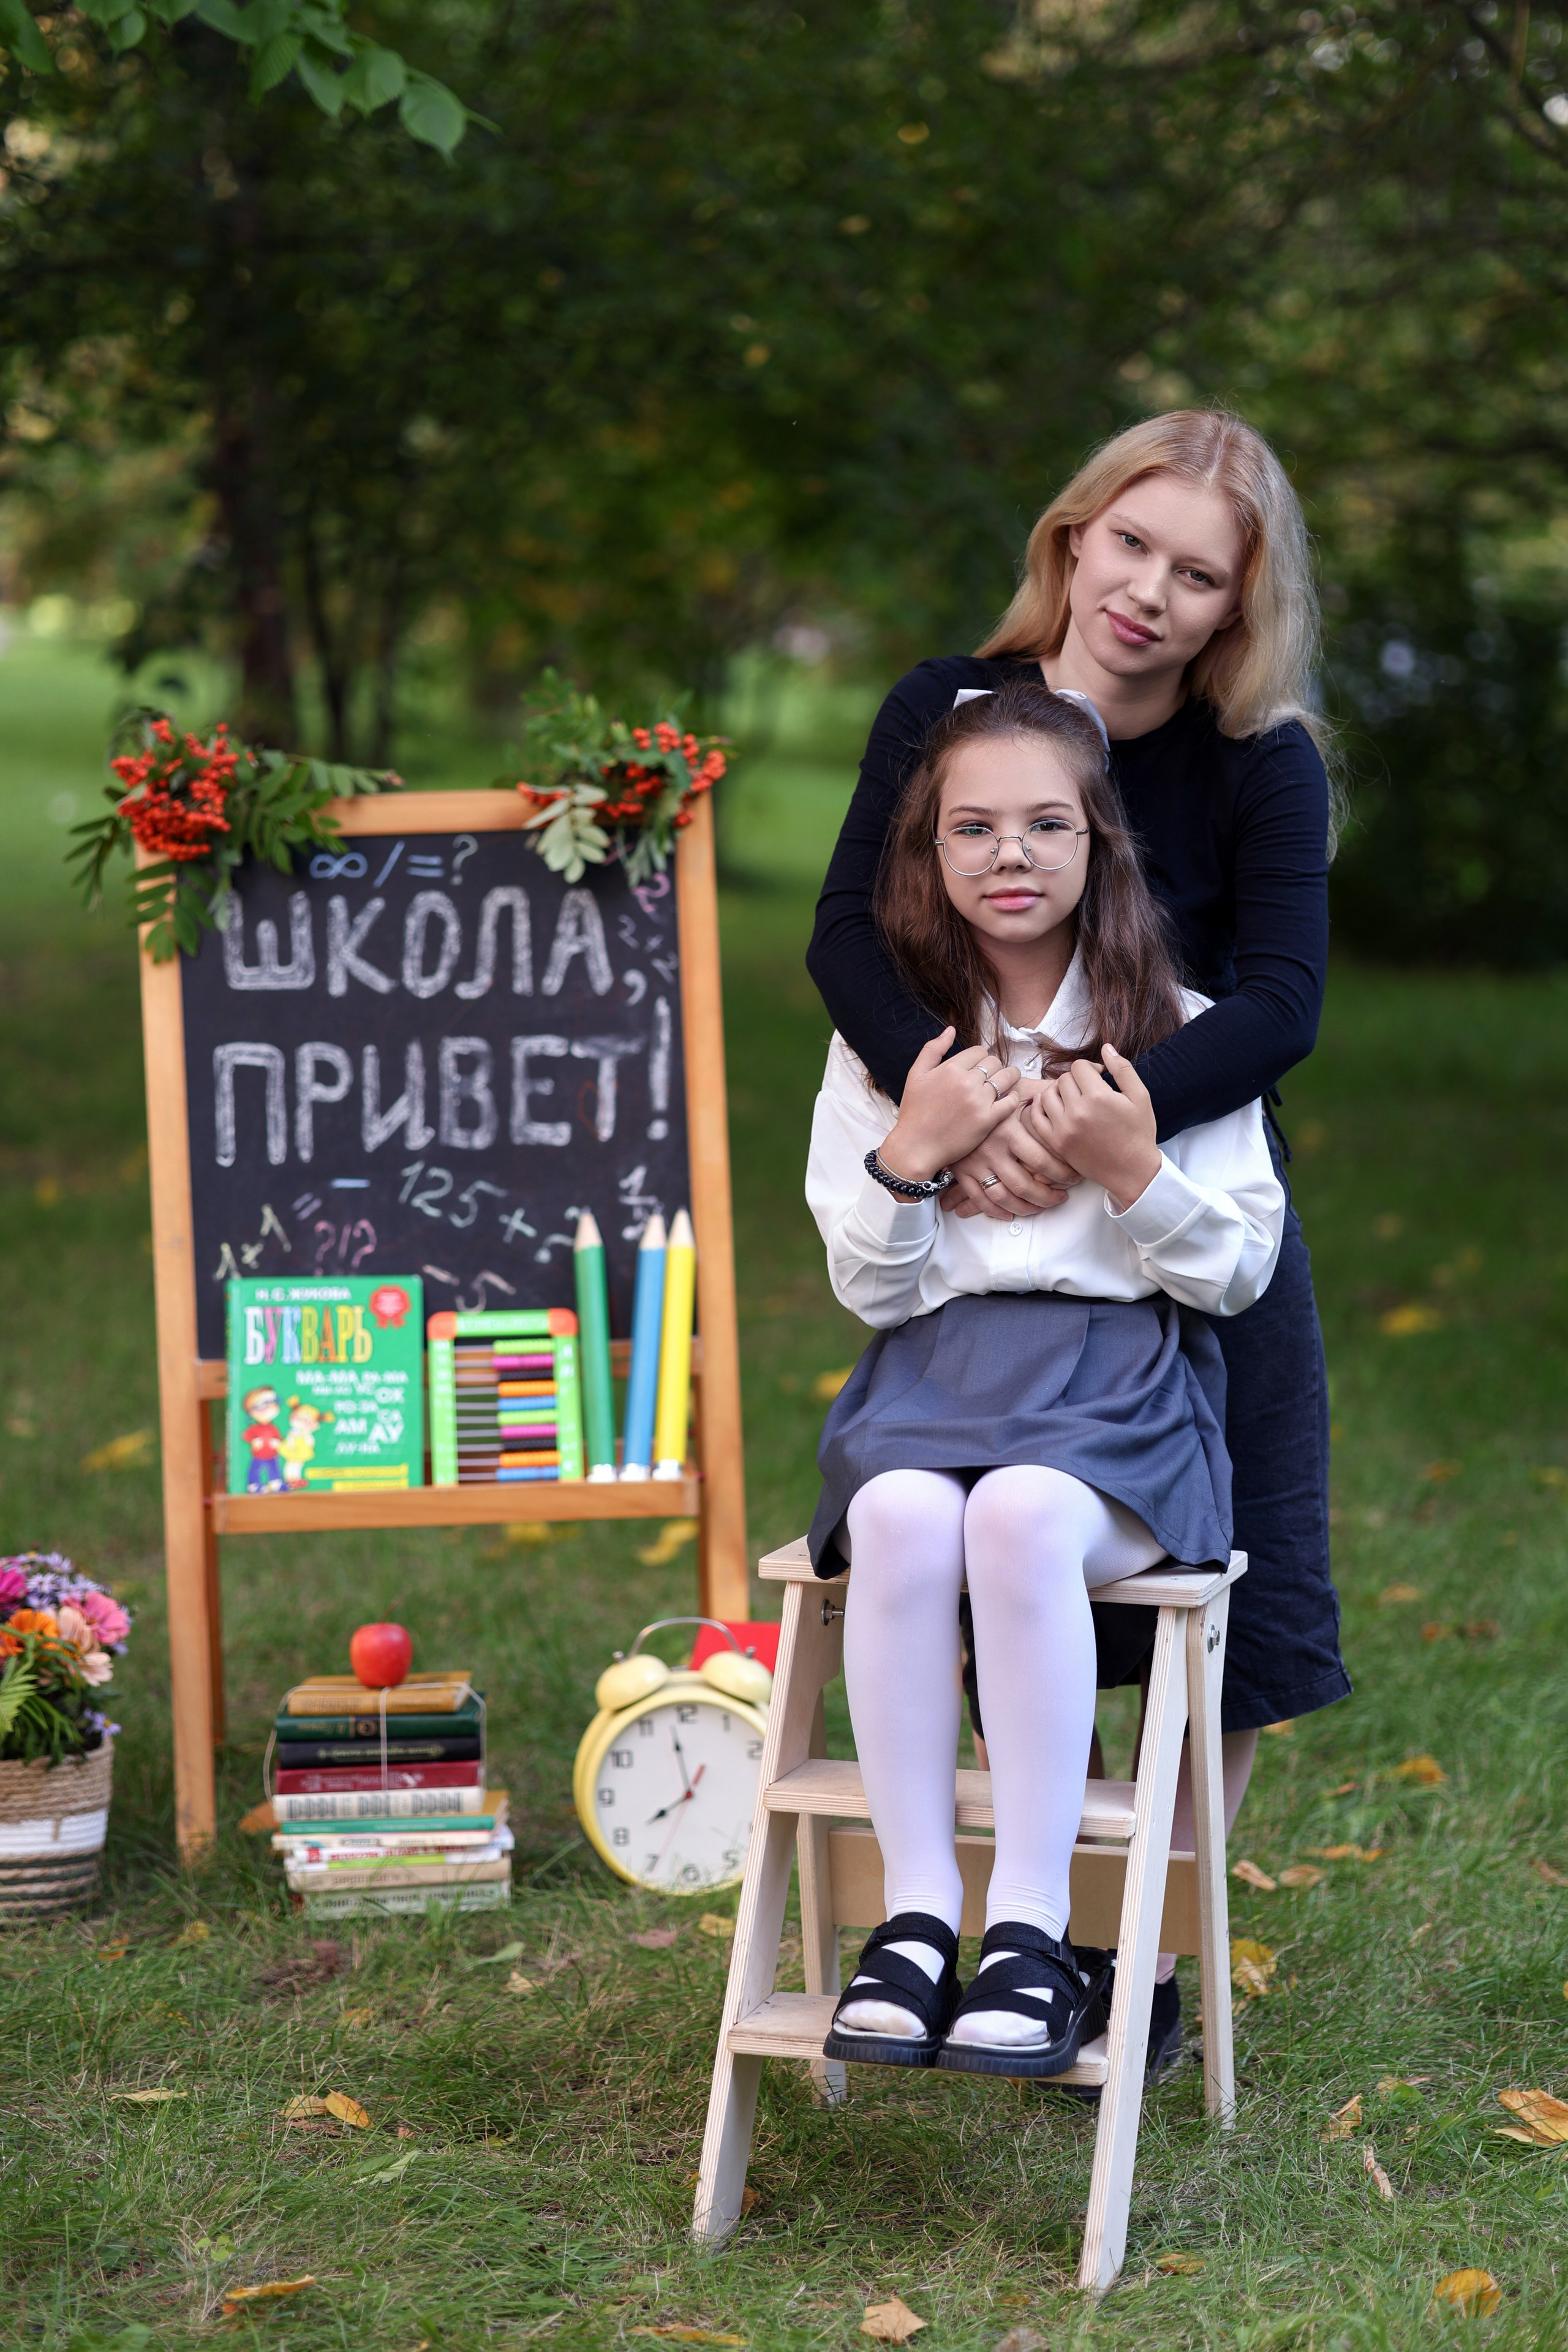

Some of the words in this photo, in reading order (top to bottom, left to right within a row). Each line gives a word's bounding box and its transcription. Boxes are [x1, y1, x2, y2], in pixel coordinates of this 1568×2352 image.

[221, 884, 647, 1006] ШКОЛА,
[213, 995, 673, 1167] ПРИВЕТ!
[244, 1305, 374, 1365] БУКВАРЬ
[368, 1422, 405, 1444] АУ
[676, 1704, 698, 1724] 12
[639, 1719, 654, 1736] 11
[609, 1749, 633, 1768] 10
[747, 1741, 764, 1760] 2
[598, 1787, 614, 1807] 9
[613, 1828, 629, 1846] 8
[646, 1853, 661, 1872] 7
[722, 1849, 739, 1868] 5
[682, 1864, 700, 1883] 6
